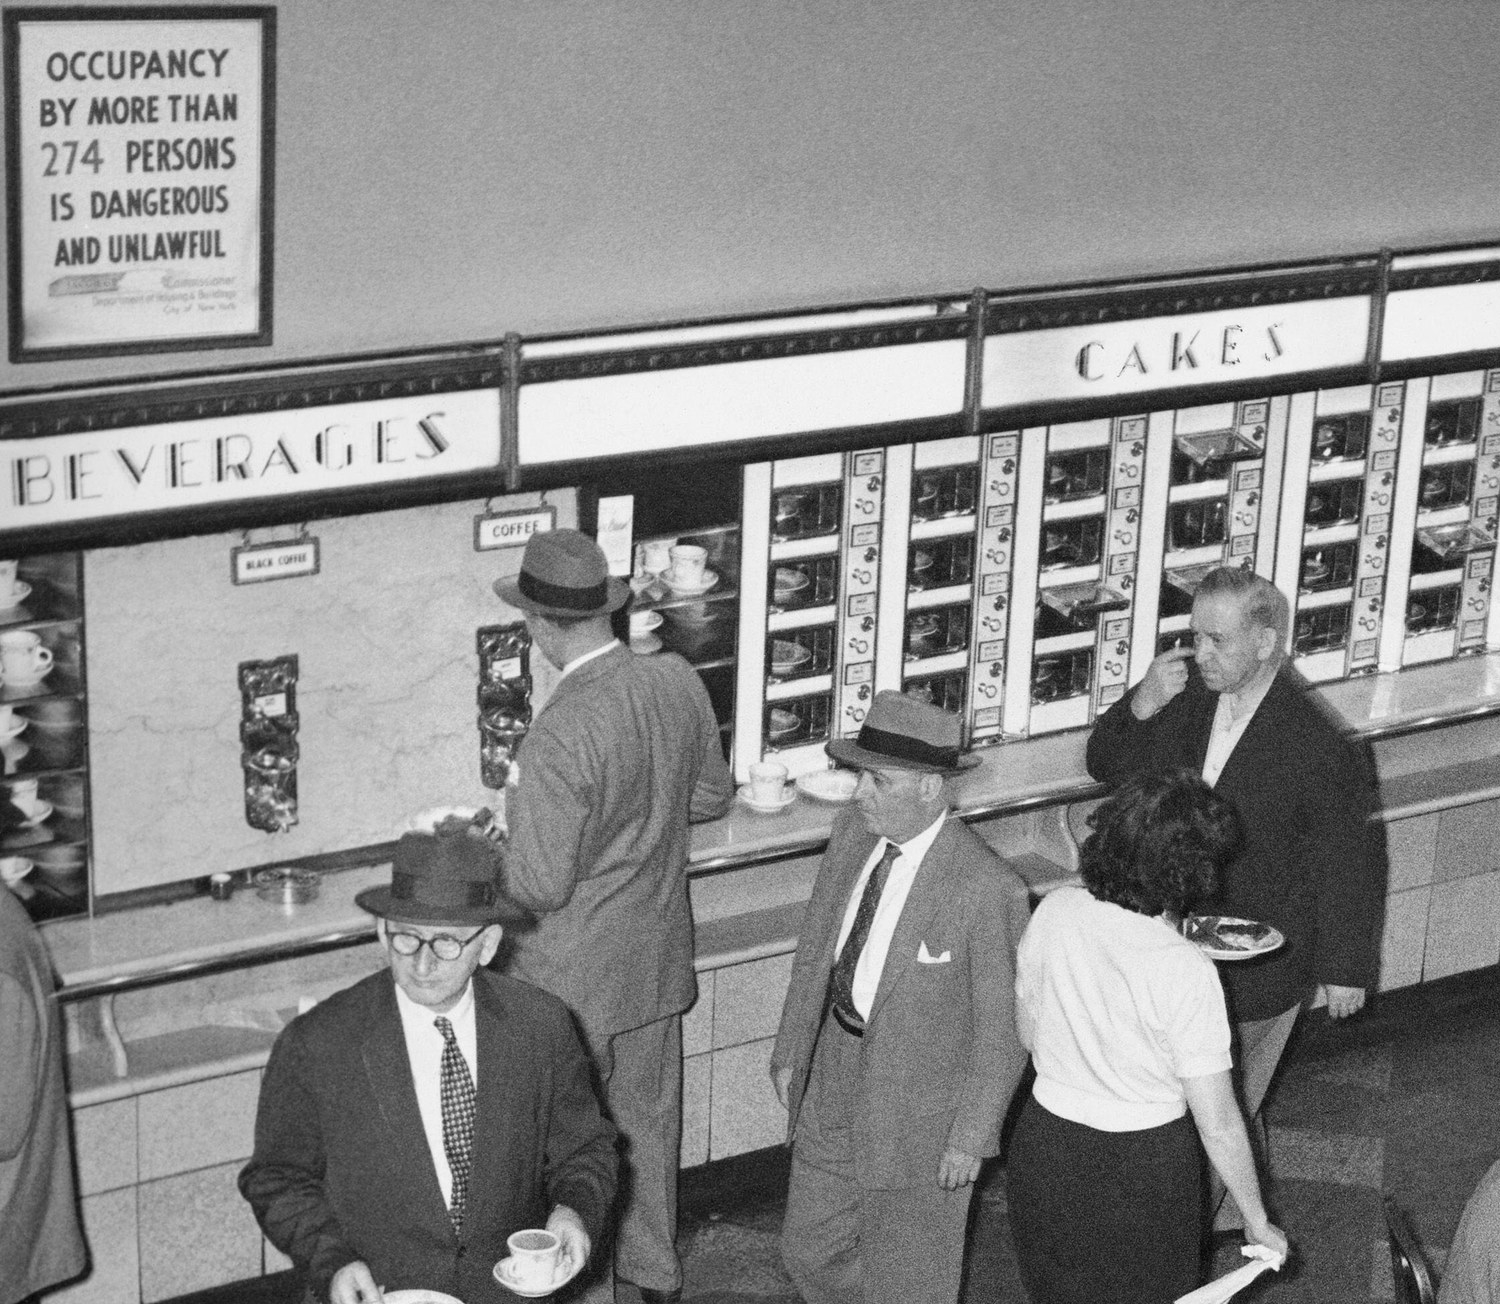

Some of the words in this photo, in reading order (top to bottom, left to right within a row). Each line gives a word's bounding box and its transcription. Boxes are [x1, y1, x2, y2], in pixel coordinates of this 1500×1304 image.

[47, 48, 230, 81] OCCUPANCY
[40, 98, 78, 127] BY
[87, 95, 159, 125] MORE
[167, 93, 238, 122] THAN
[41, 139, 104, 177] 274
[126, 136, 237, 173] PERSONS
[51, 193, 75, 222] IS
[90, 184, 229, 219] DANGEROUS
[54, 236, 100, 266] AND
[108, 229, 226, 263] UNLAWFUL
[1075, 321, 1286, 381] CAKES
[11, 411, 452, 506] BEVERAGES
[492, 520, 540, 538] COFFEE
[246, 556, 273, 571] BLACK
[278, 552, 307, 567] COFFEE
